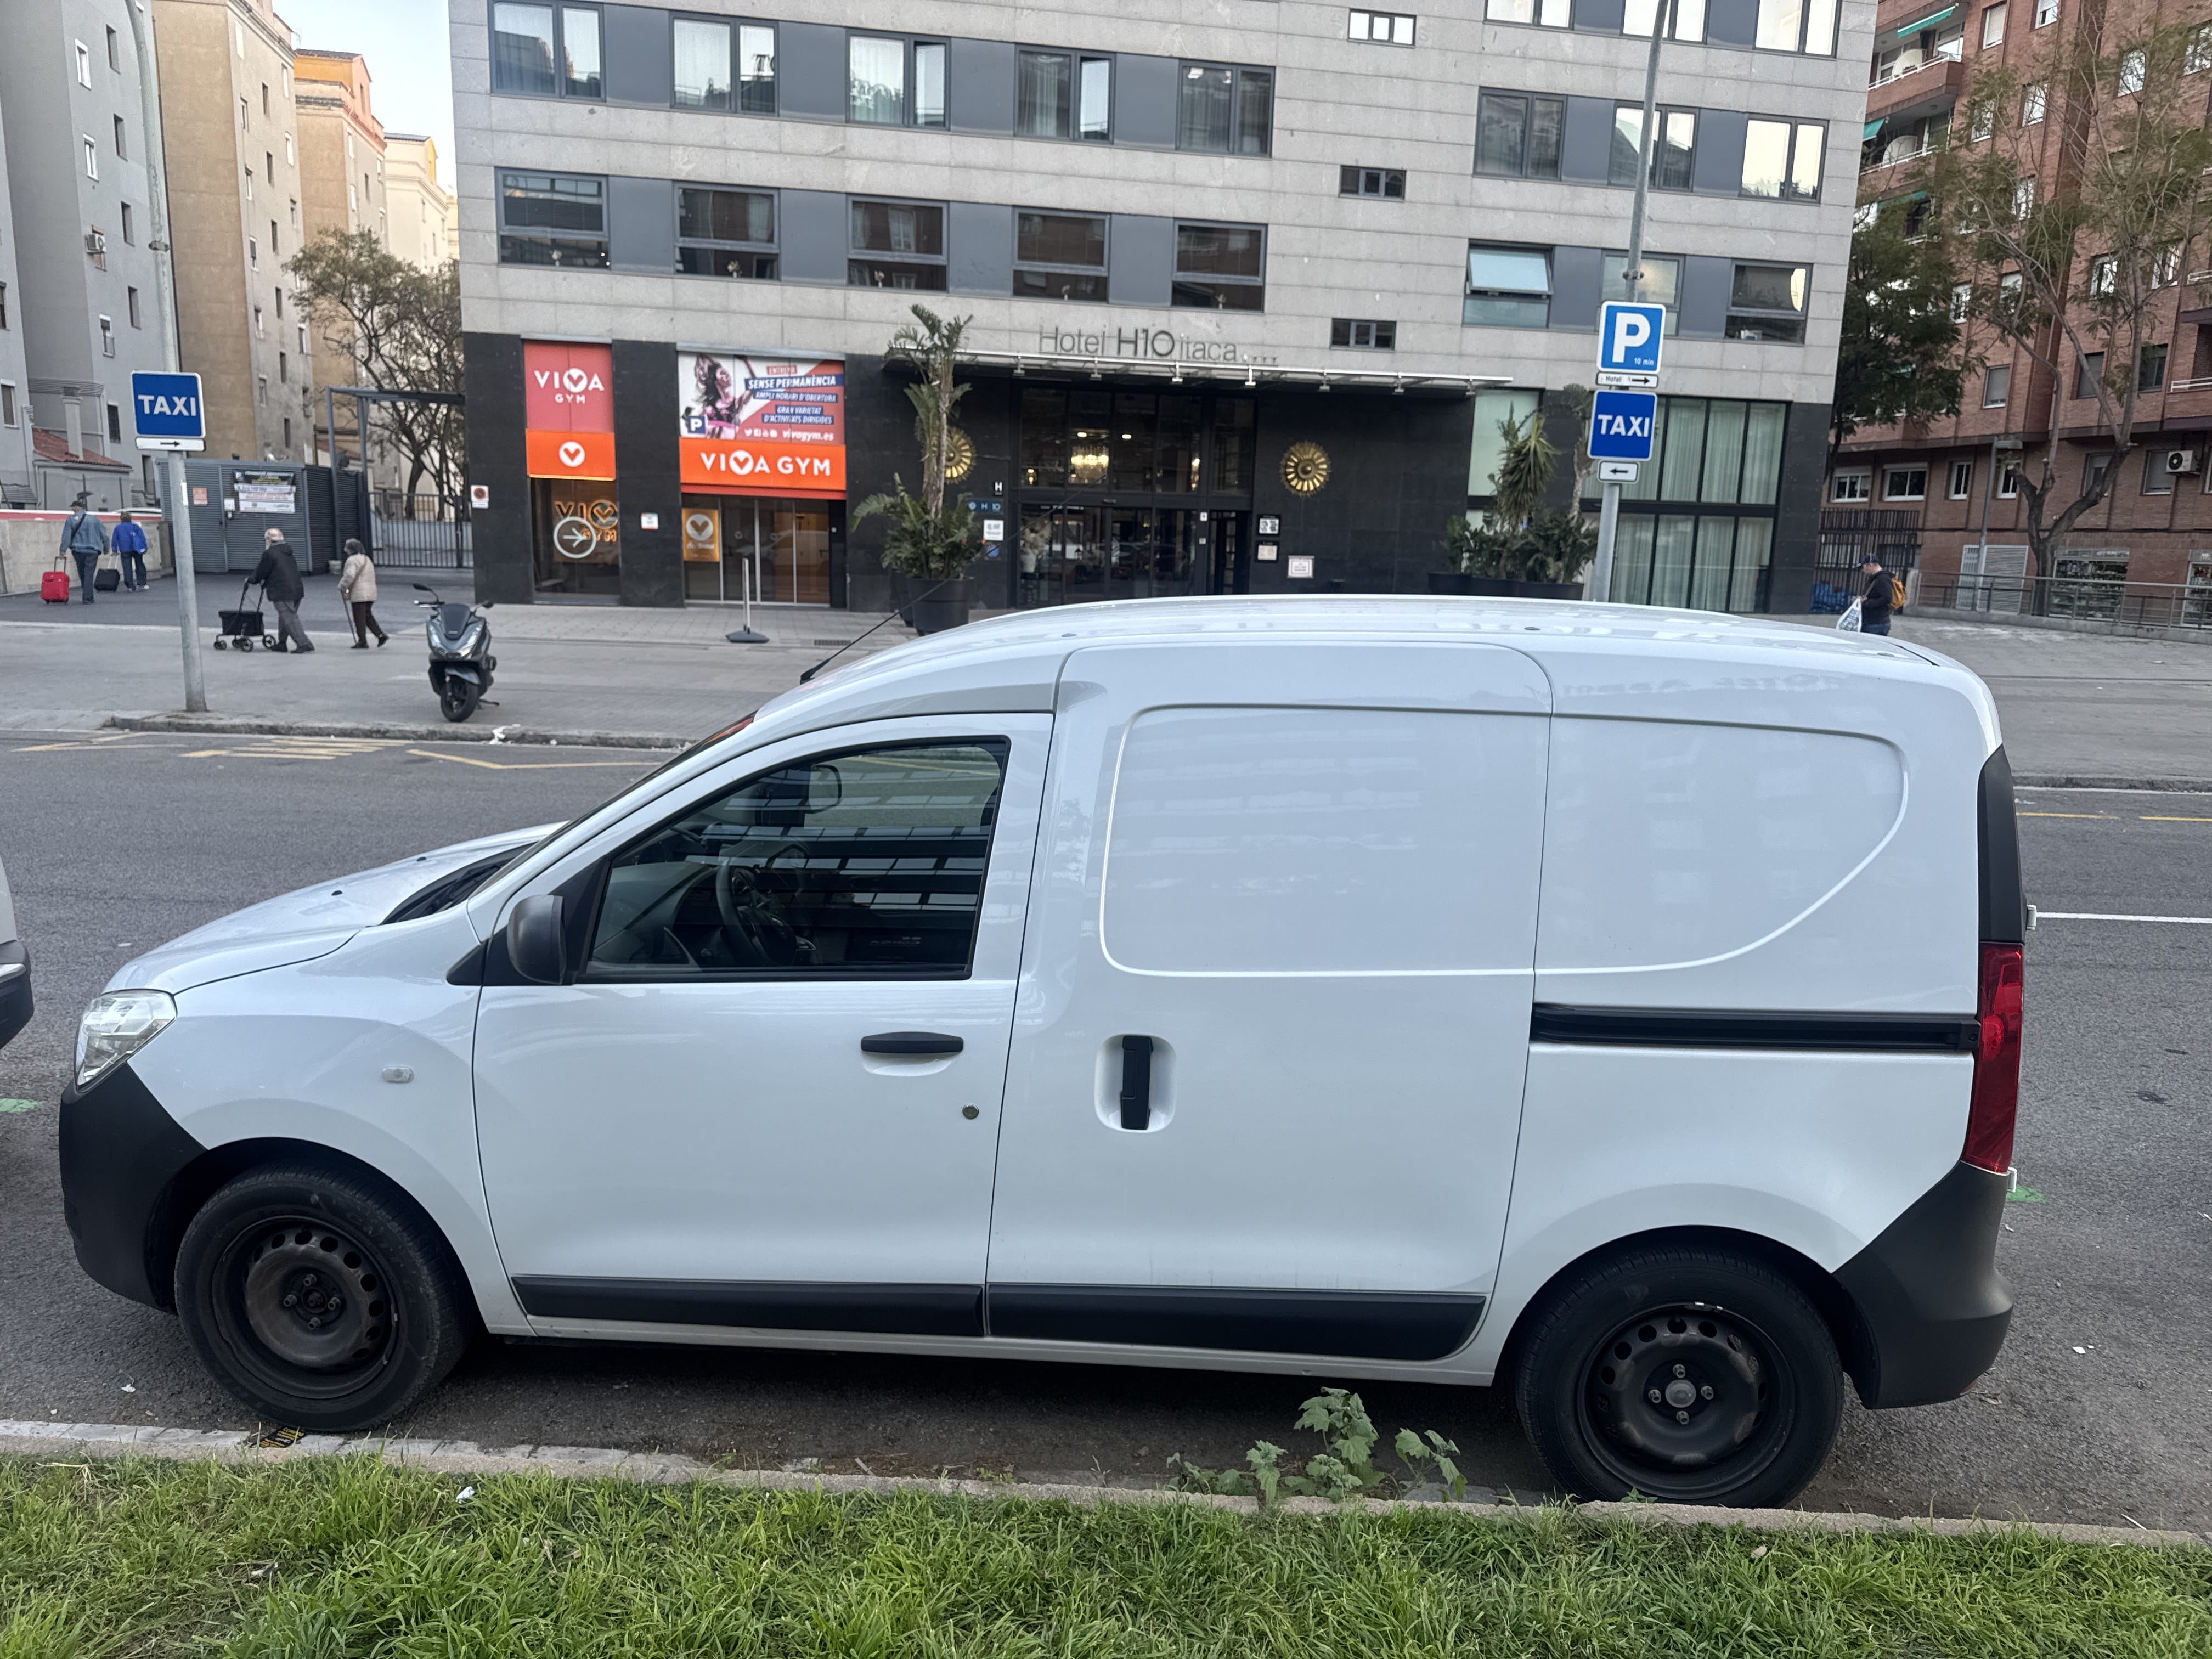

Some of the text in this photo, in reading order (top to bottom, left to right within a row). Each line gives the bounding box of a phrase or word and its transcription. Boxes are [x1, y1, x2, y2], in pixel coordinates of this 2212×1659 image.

[1039, 325, 1105, 356] Hotel
[1117, 326, 1175, 357] H10
[1612, 312, 1651, 363] P
[1634, 357, 1654, 366] 10 min
[534, 368, 604, 393] VIVA
[748, 379, 775, 390] SENSE
[138, 394, 196, 416] TAXI
[555, 393, 585, 404] GYM
[777, 405, 794, 414] GRAN
[690, 418, 702, 432] P
[1597, 414, 1650, 437] TAXI
[700, 450, 831, 476] VIVA GYM
[995, 481, 1002, 492] H
